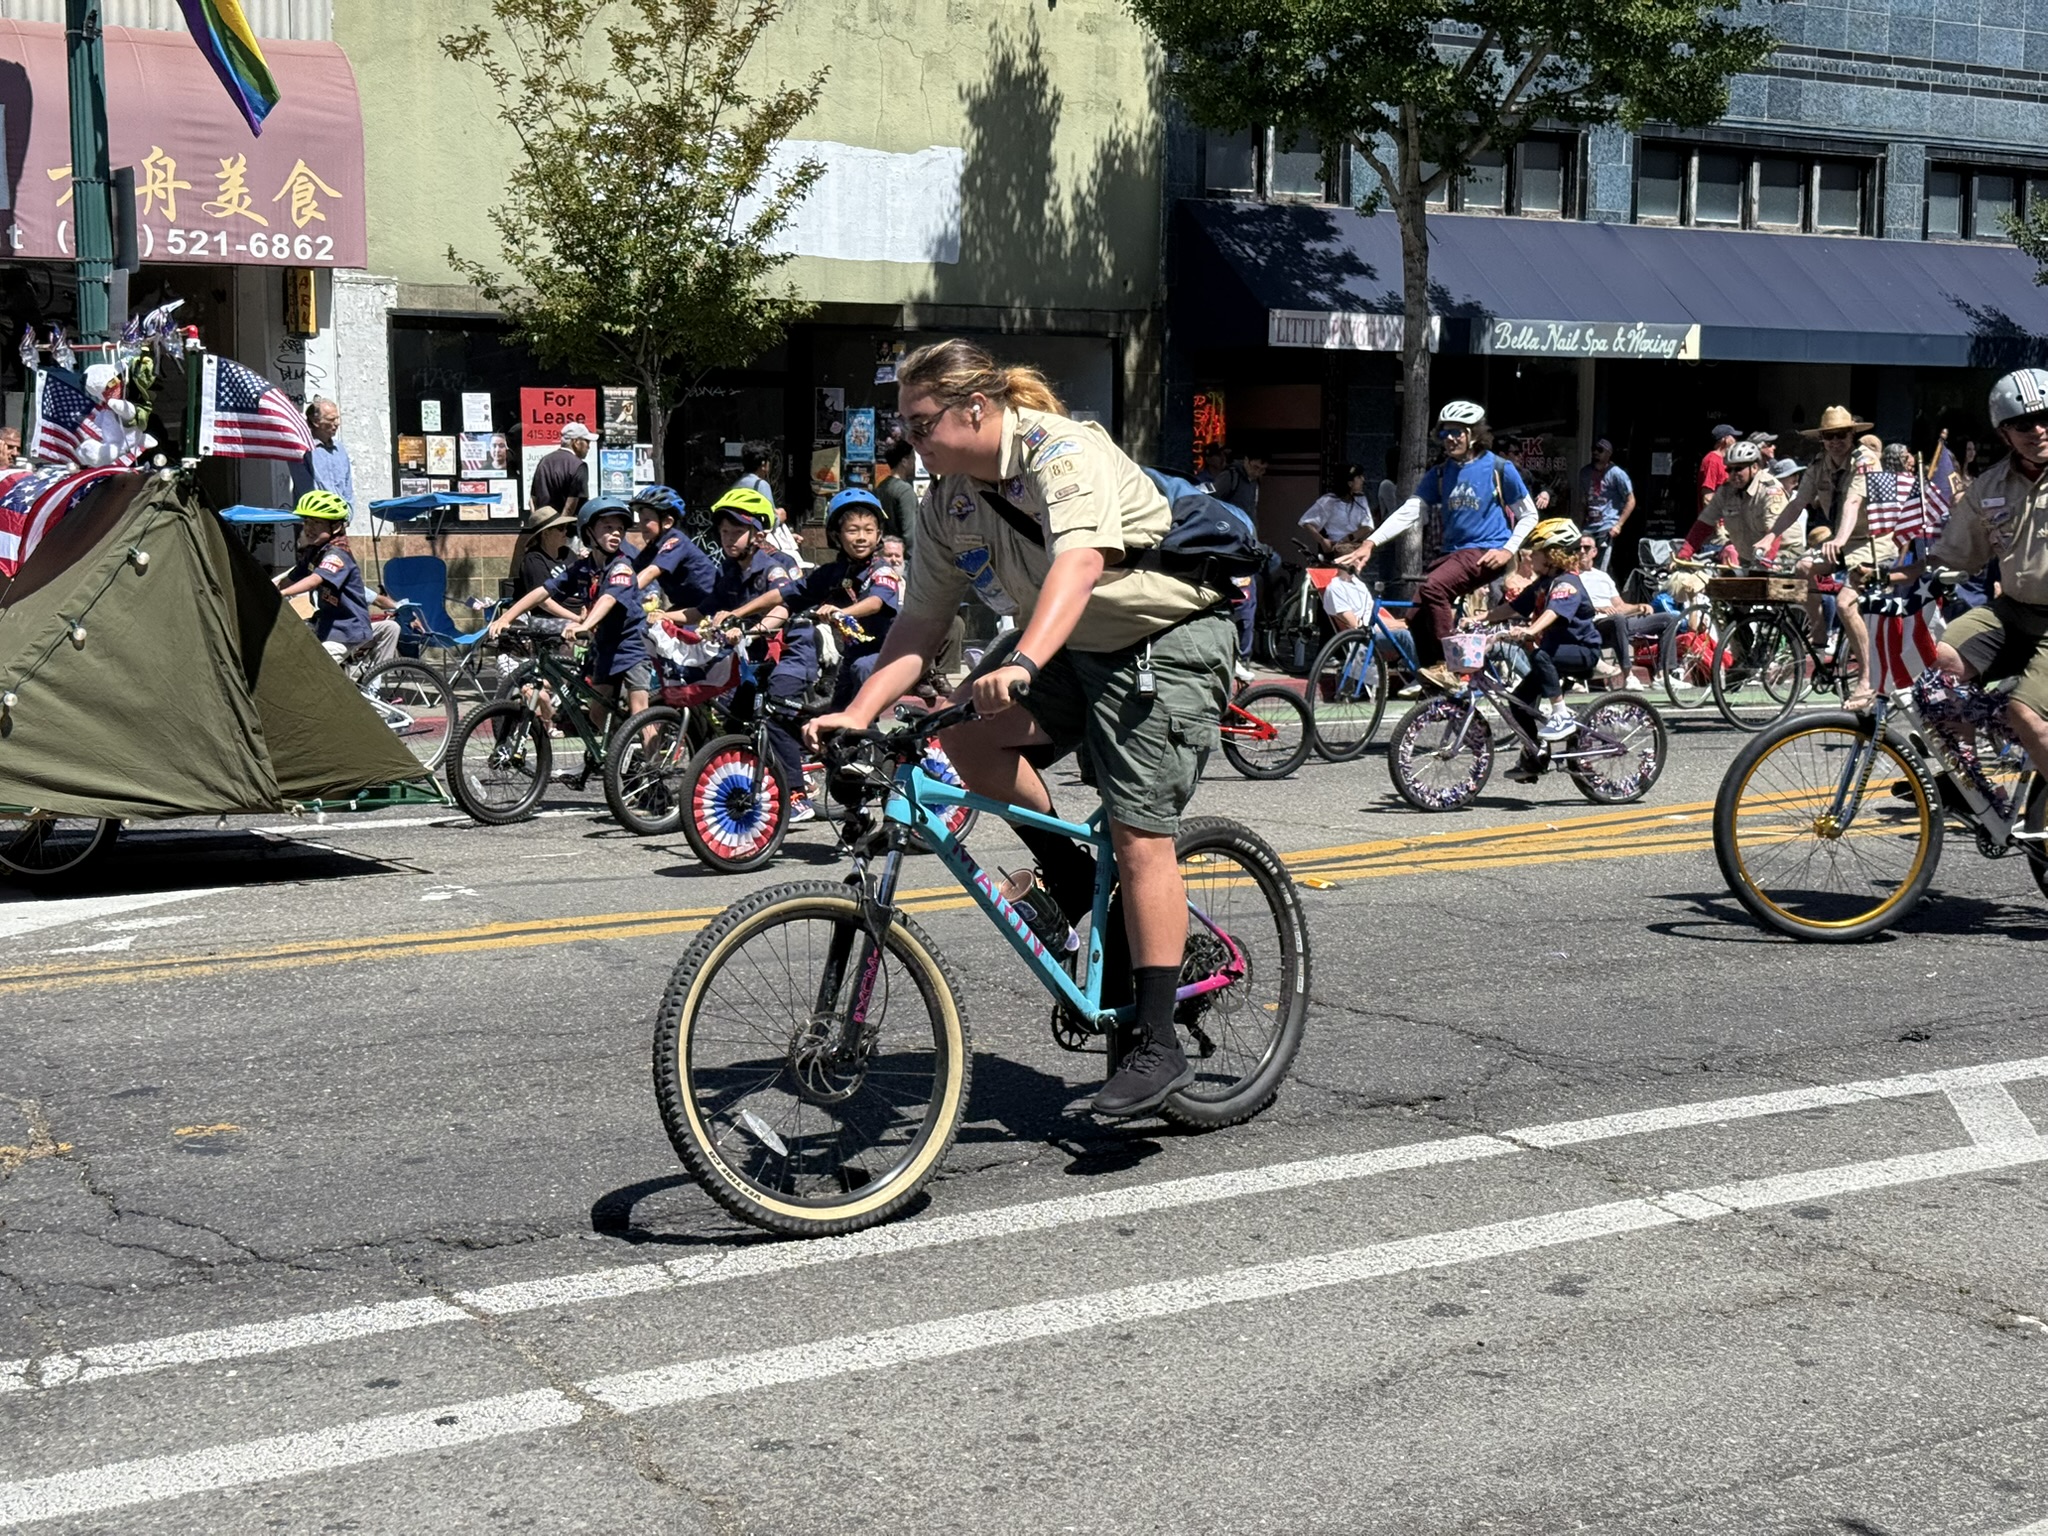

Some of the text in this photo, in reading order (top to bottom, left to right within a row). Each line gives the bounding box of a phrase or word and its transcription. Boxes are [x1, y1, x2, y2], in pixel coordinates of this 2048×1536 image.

[47, 145, 343, 229] 舟美食
[167, 229, 335, 261] 521-6862
[1276, 317, 1329, 345] LITTLE
[1495, 322, 1678, 359] Bella Nail Spa & Waxing
[543, 391, 575, 407] For
[532, 409, 586, 425] Lease
[527, 430, 561, 440] 415.39
[1051, 459, 1074, 476] 89
[950, 844, 1045, 958] MARIN
